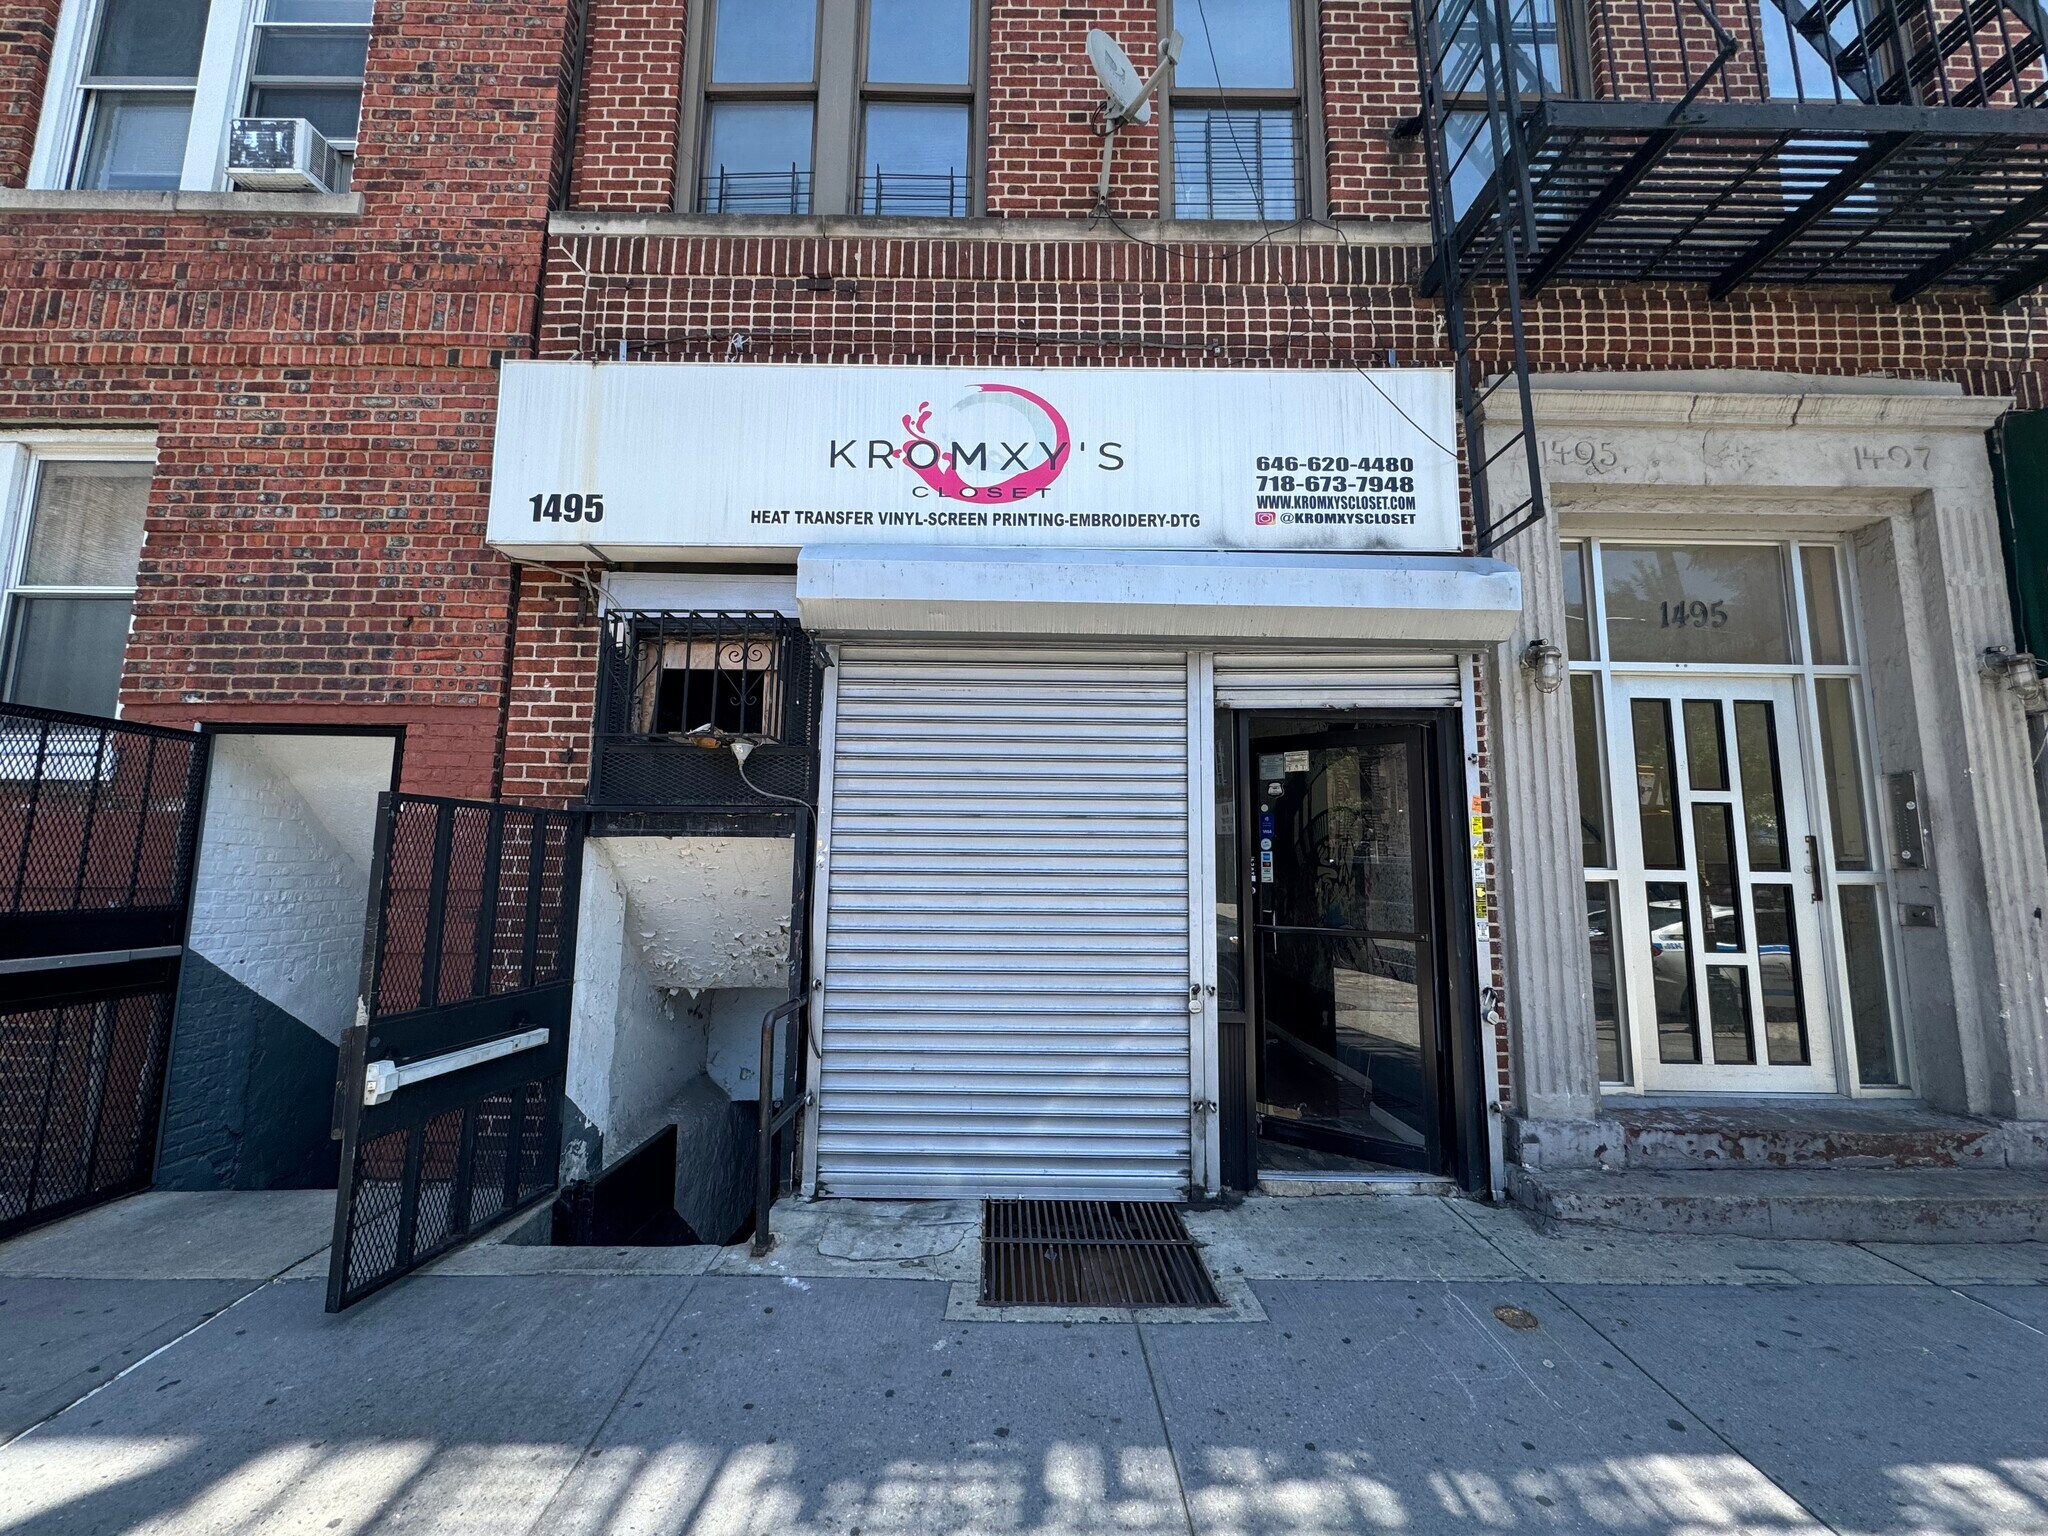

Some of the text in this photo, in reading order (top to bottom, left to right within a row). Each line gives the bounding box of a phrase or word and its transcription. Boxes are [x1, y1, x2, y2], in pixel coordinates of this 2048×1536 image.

[830, 439, 1124, 471] KROMXY'S
[1541, 441, 1618, 467] 1495
[1853, 444, 1932, 471] 1497
[1256, 456, 1414, 473] 646-620-4480
[912, 485, 1051, 499] CLOSET
[1256, 475, 1414, 493] 718-673-7948
[529, 493, 604, 523] 1495
[1256, 495, 1416, 510] WWW.KROMXYSCLOSET.COM
[750, 510, 1201, 528] HEAT TRANSFER VINYL-SCREEN PRINTING-EMBROIDERY-DTG
[1280, 512, 1416, 525] @KROMXYSCLOSET
[1660, 600, 1728, 628] 1495
